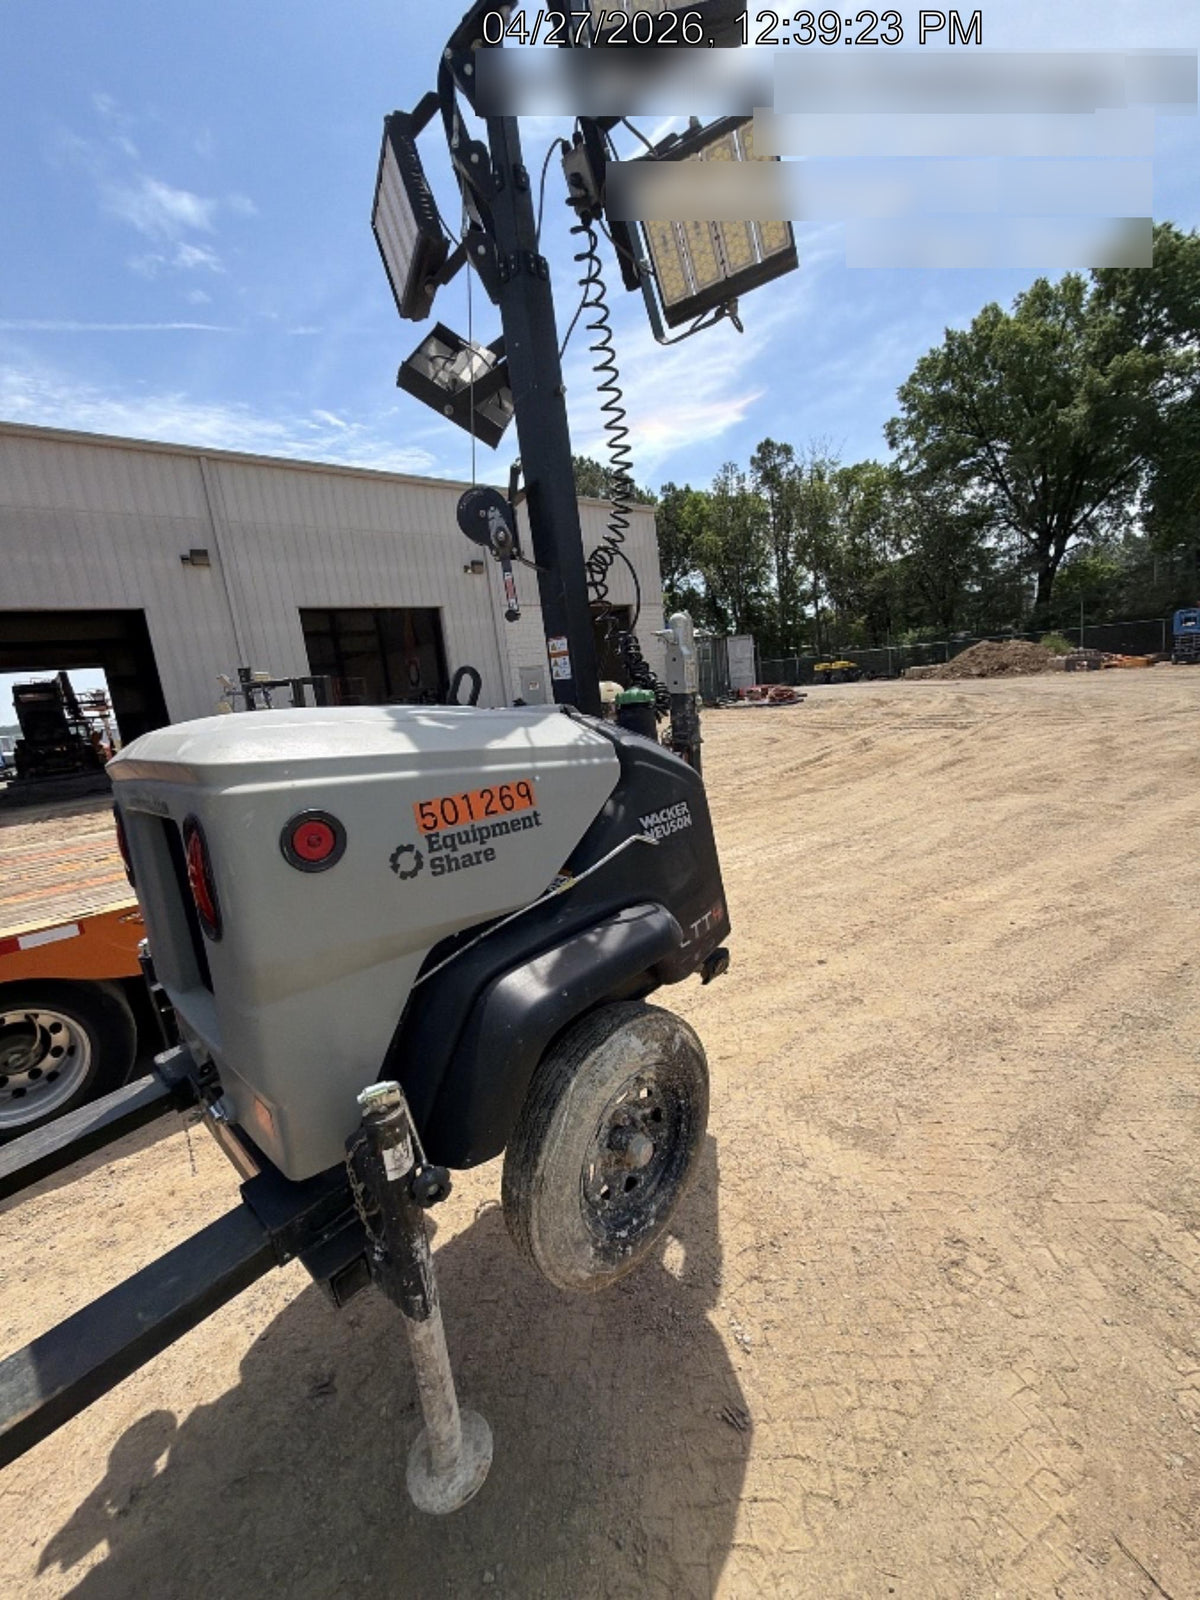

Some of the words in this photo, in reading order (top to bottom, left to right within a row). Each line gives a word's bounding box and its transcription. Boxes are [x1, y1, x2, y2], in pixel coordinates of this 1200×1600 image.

[419, 781, 532, 831] 501269
[638, 801, 689, 829] WACKER
[425, 810, 542, 853] Equipment
[430, 847, 496, 876] Share
